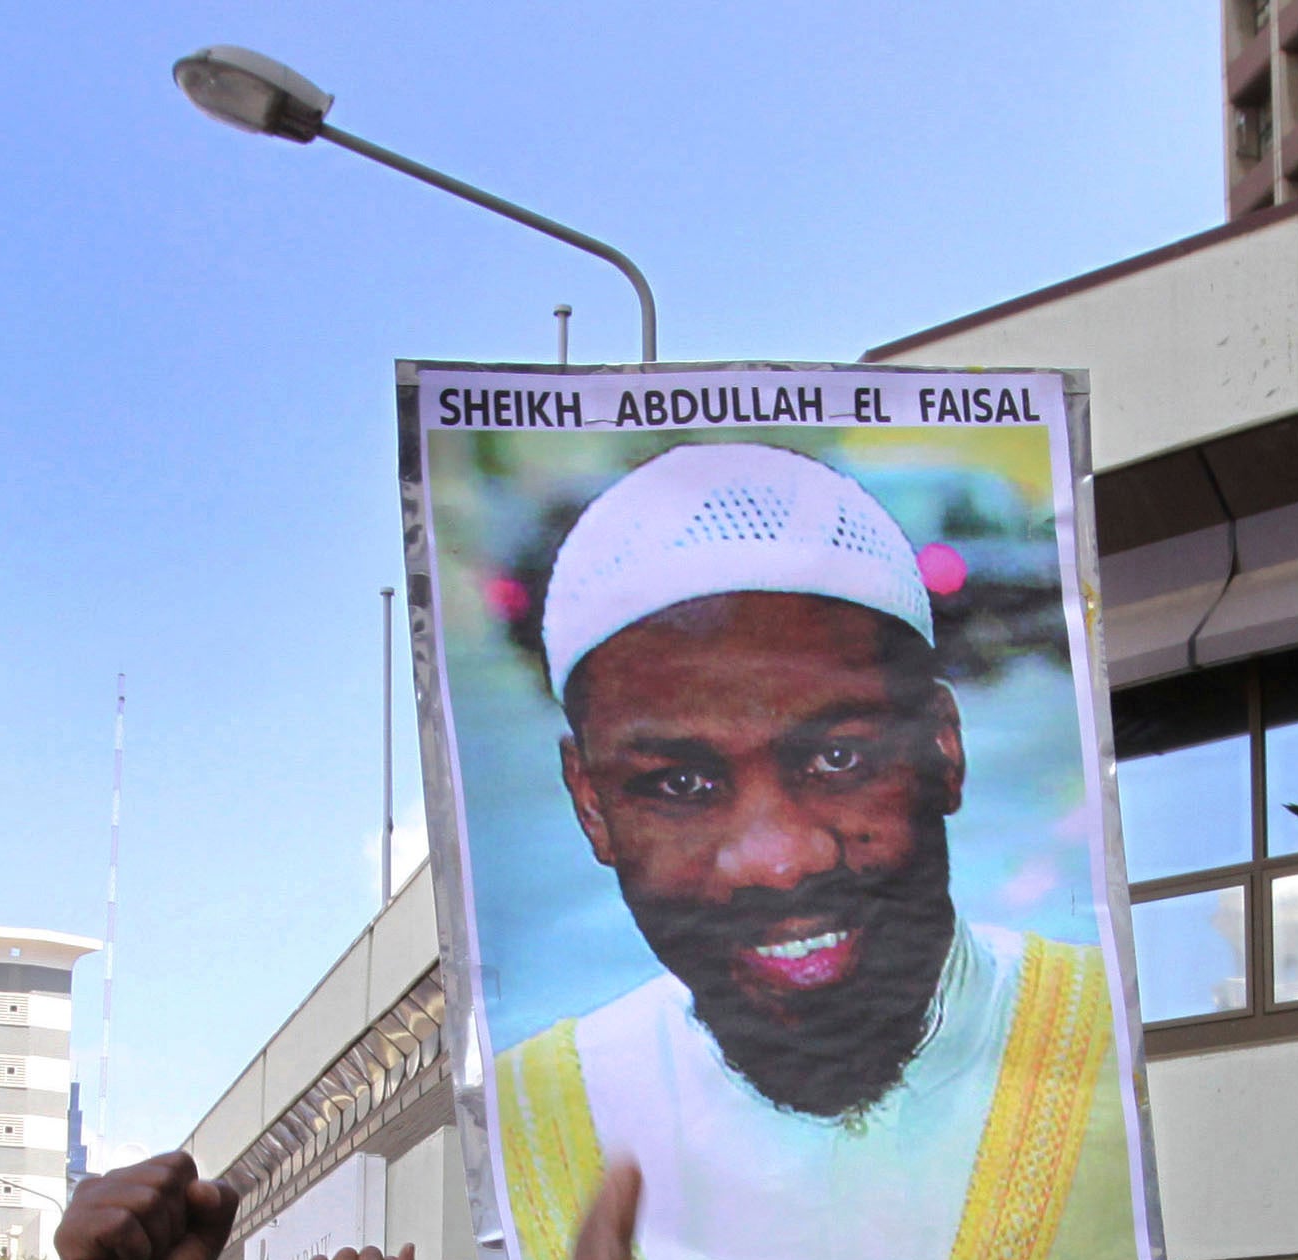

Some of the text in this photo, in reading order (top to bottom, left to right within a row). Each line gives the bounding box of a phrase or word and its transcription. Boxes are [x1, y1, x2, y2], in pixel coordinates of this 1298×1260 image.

[439, 386, 1040, 427] SHEIKH ABDULLAH EL FAISAL
